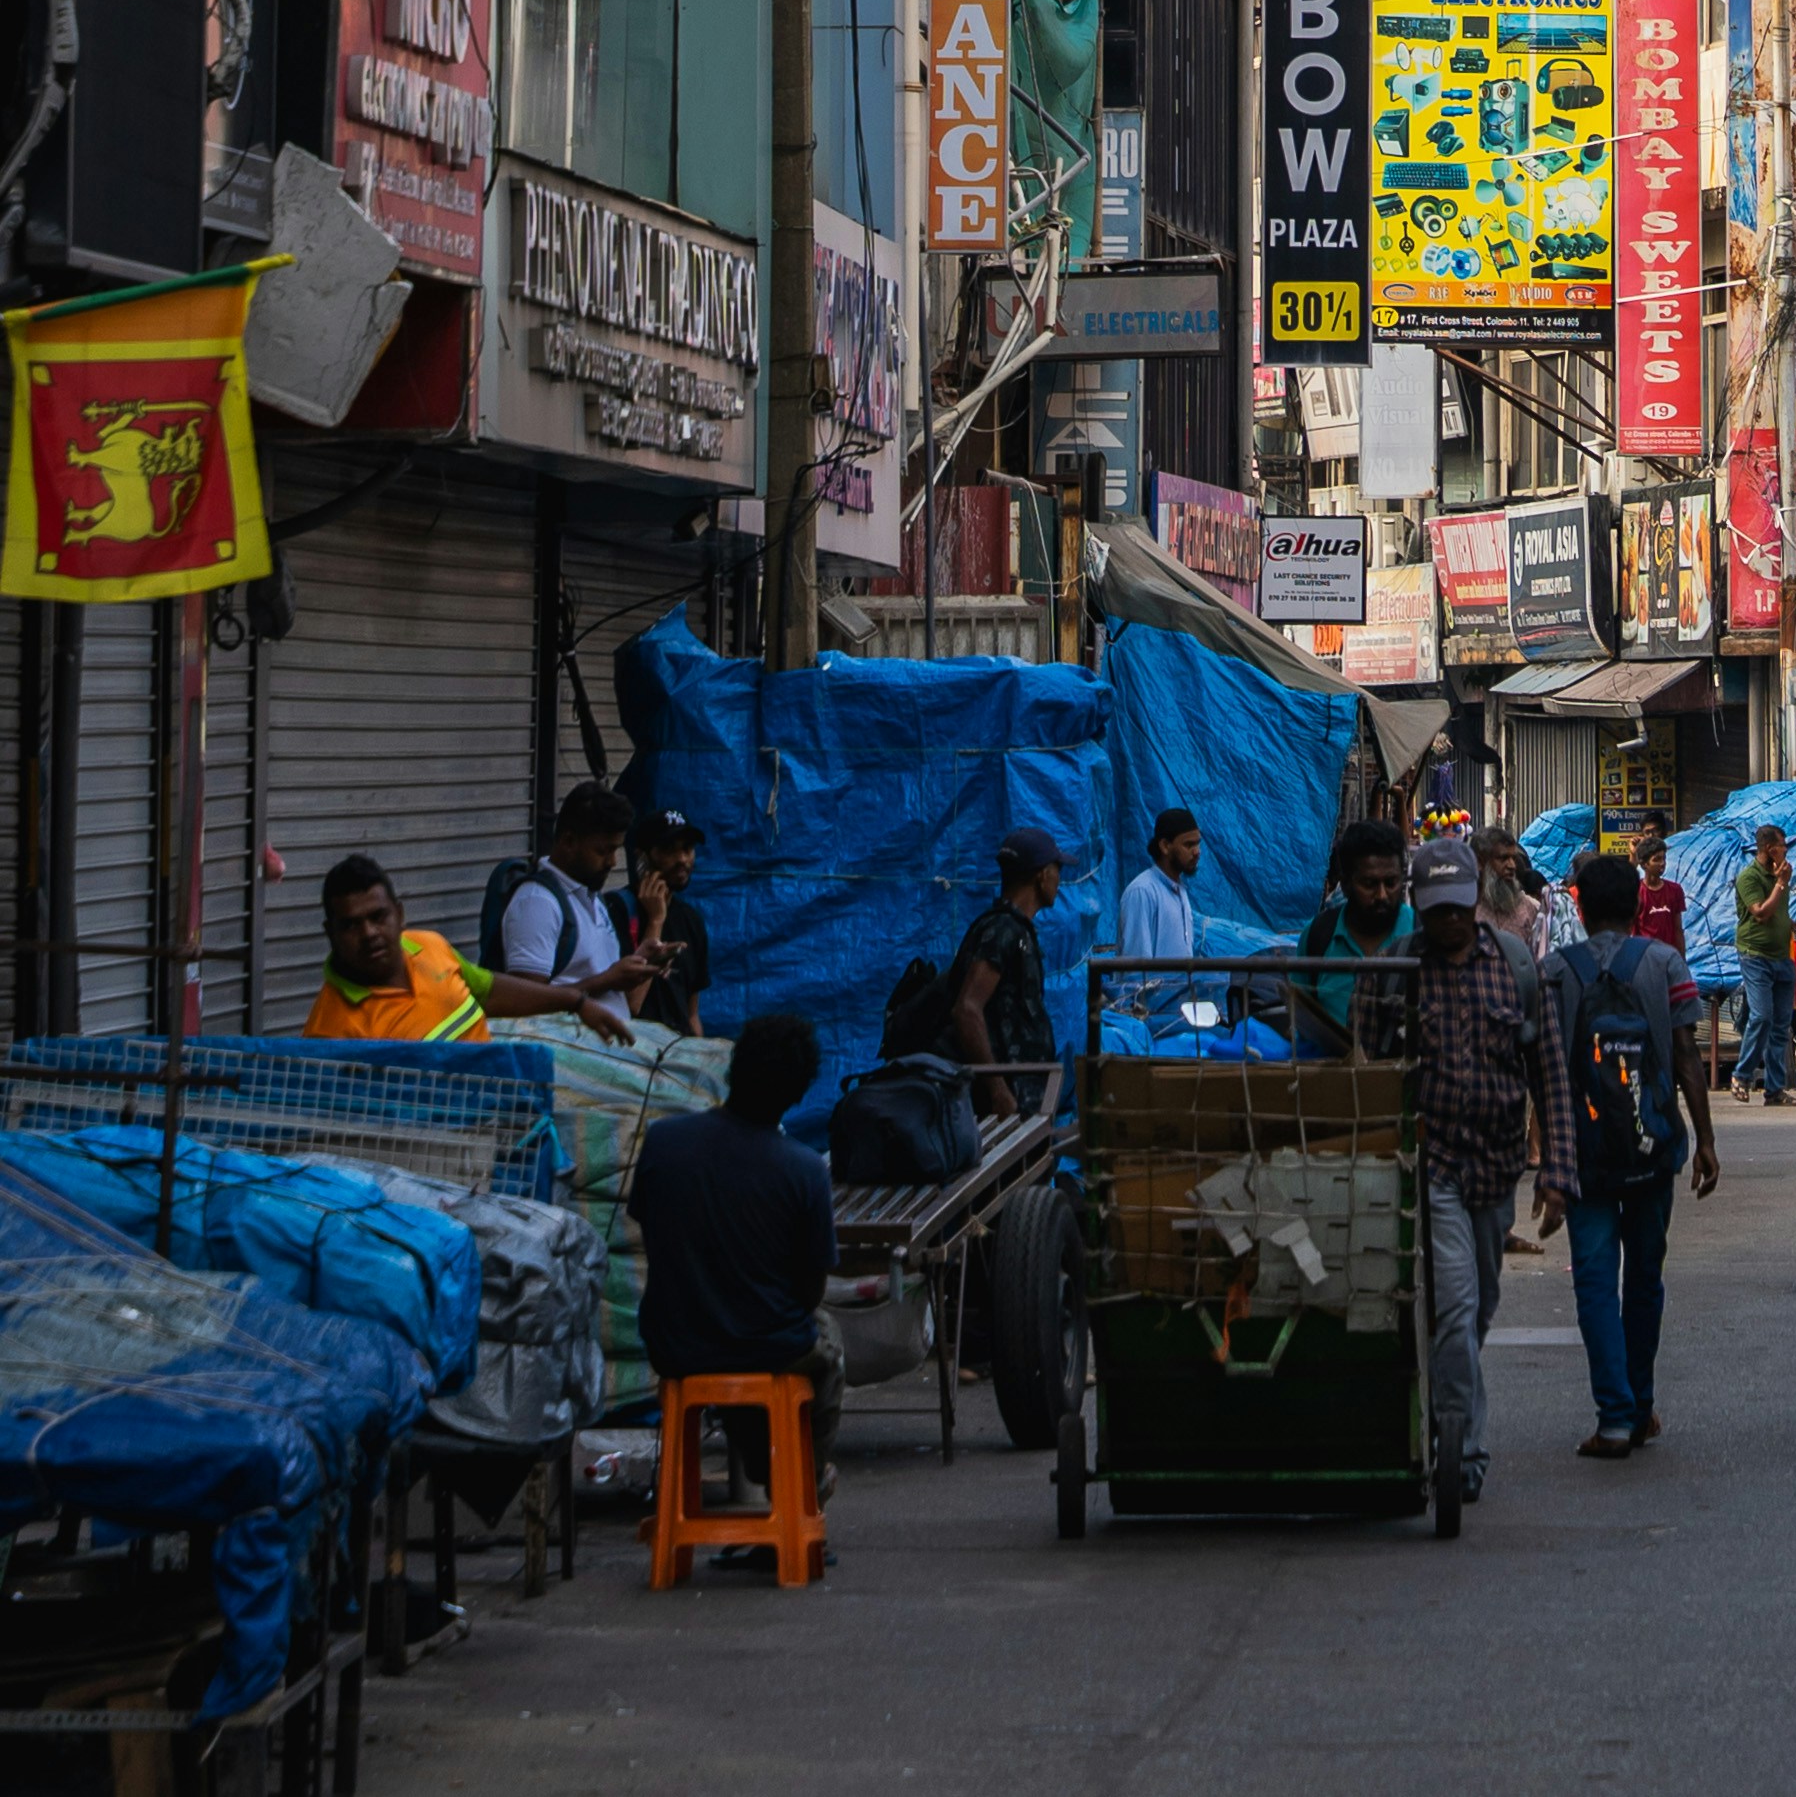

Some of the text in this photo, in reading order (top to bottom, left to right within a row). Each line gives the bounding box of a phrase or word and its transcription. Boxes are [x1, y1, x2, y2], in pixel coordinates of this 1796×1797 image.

[1634, 18, 1685, 191] BOMBAY
[1268, 218, 1357, 249] PLAZA
[1630, 210, 1692, 384] SWEETS
[1084, 310, 1219, 337] ELECTRICALS
[1375, 309, 1395, 325] 17
[1422, 315, 1438, 325] First
[1370, 376, 1425, 396] Audio
[1649, 406, 1669, 418] 19
[1524, 529, 1554, 566] ROYAL
[1556, 524, 1579, 561] ASIA
